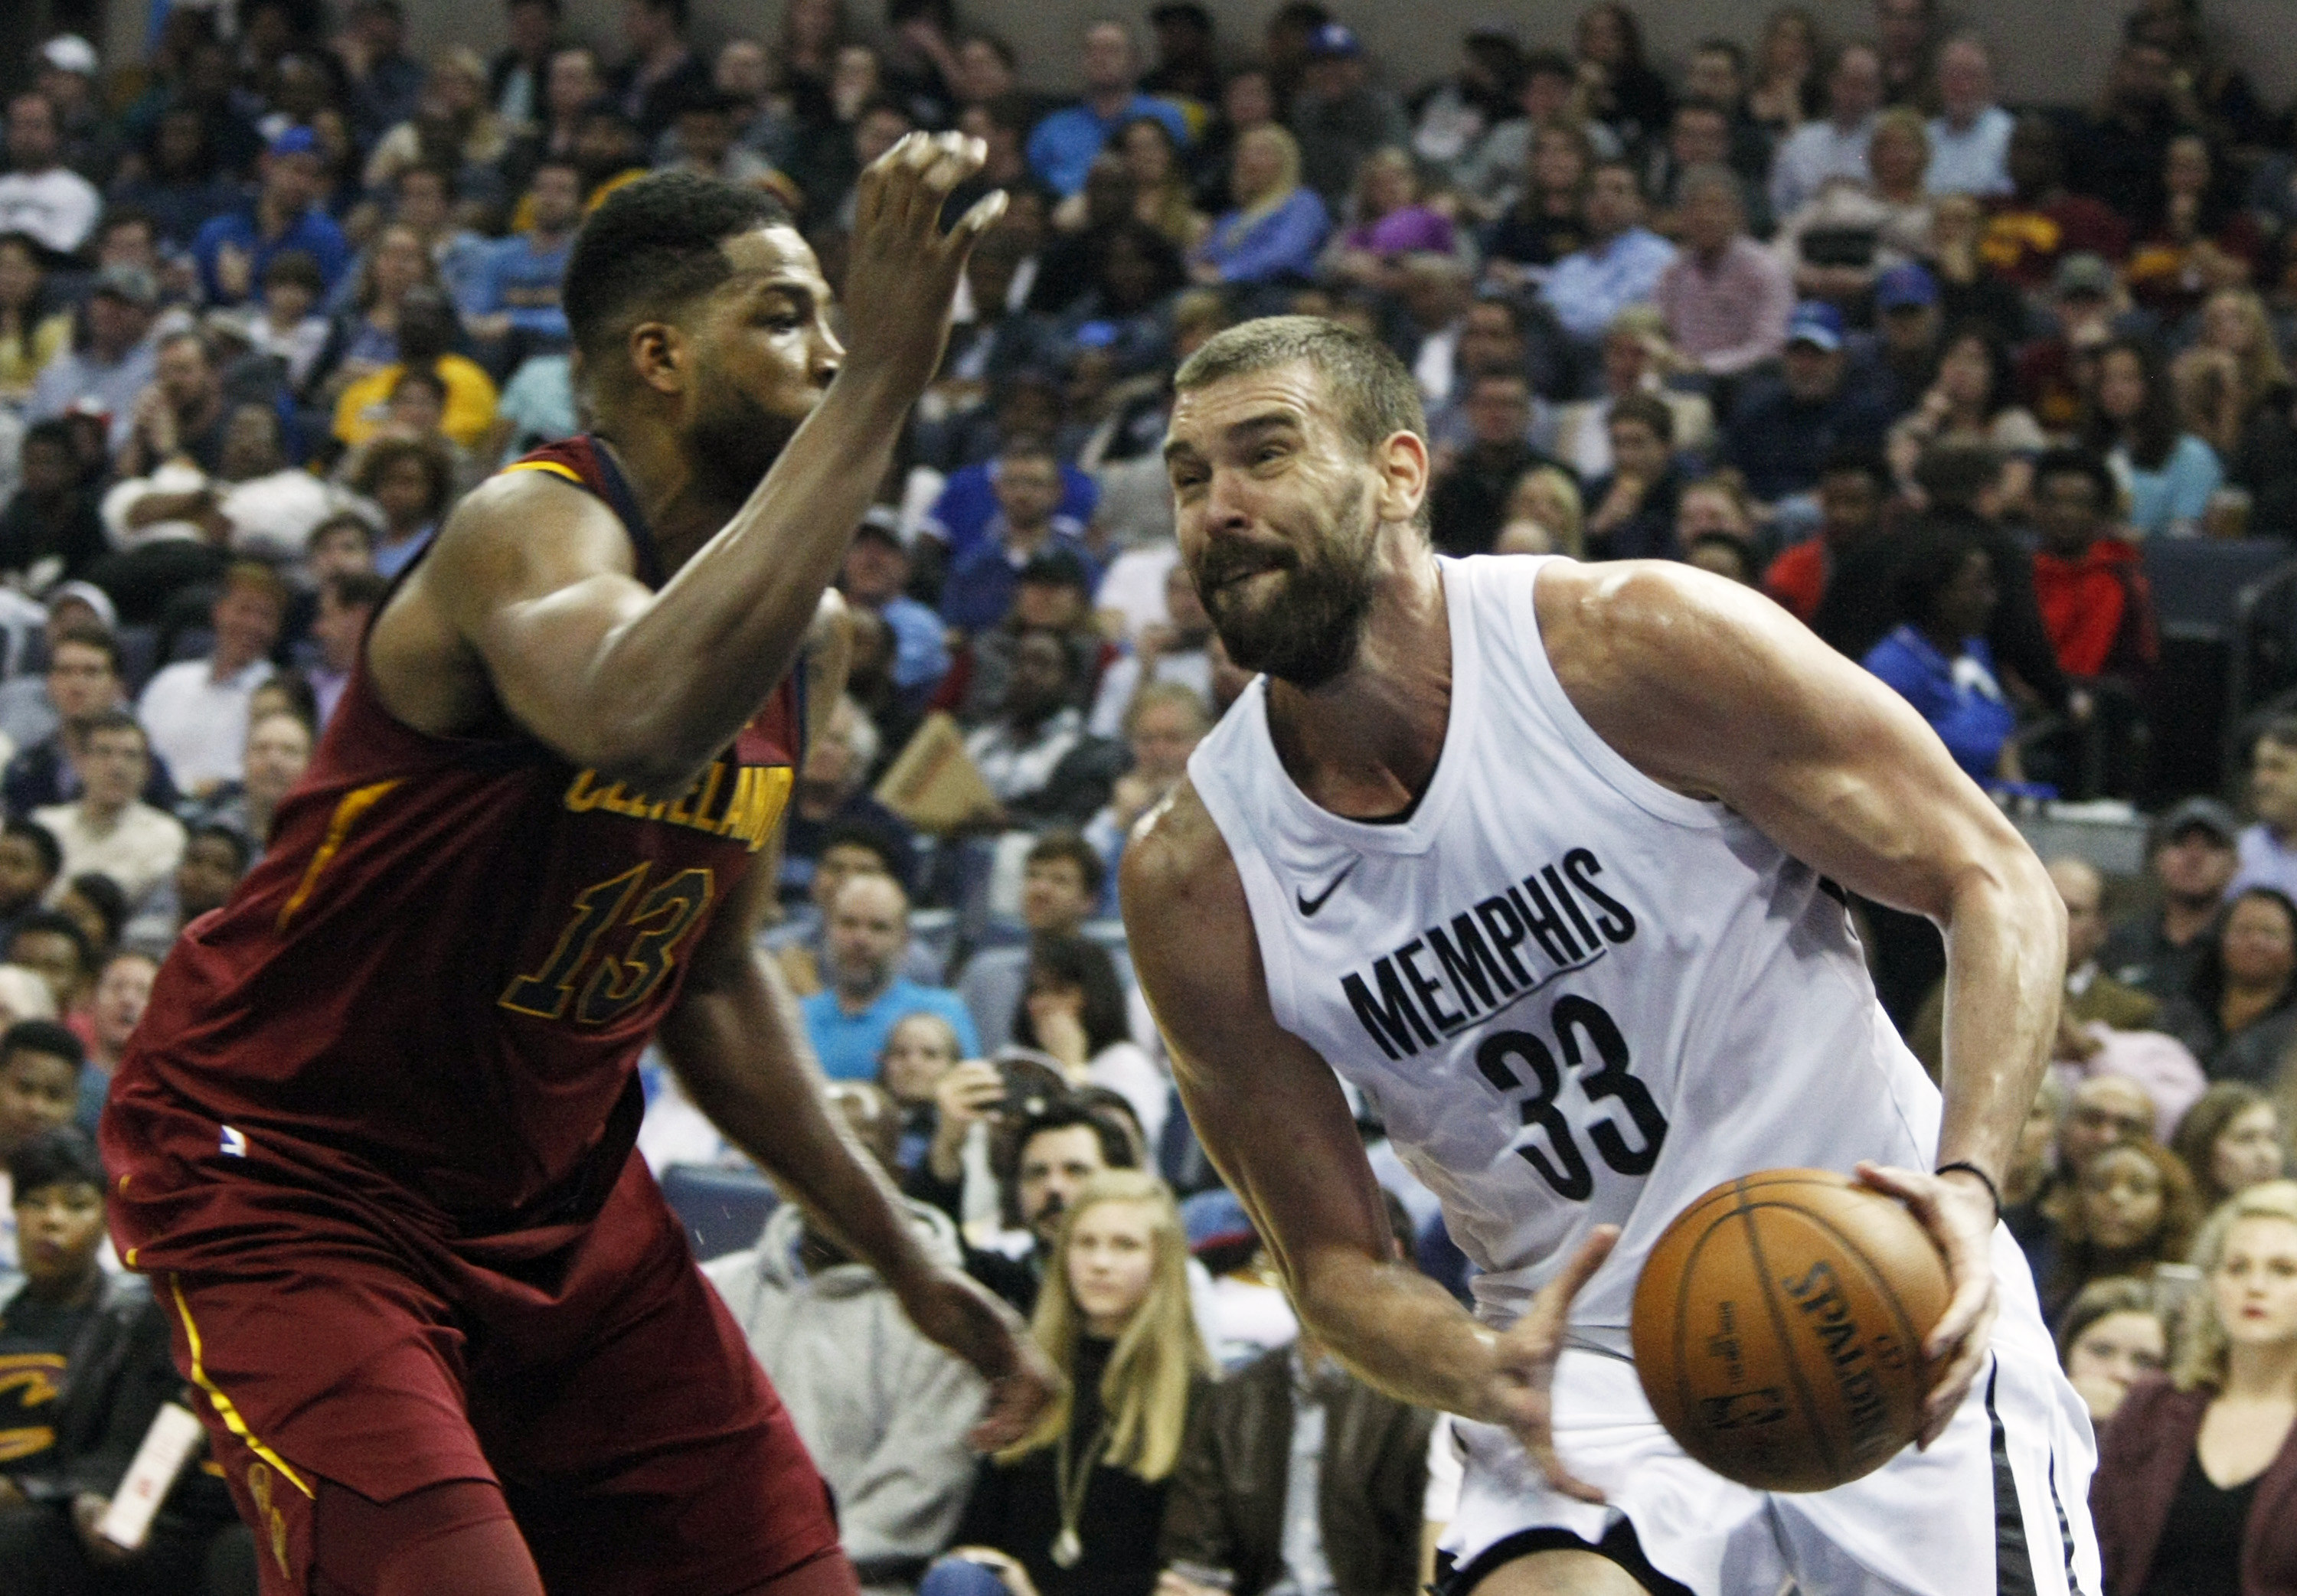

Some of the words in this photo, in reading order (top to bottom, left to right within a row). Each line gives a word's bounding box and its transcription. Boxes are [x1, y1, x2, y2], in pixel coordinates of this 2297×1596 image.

[498, 861, 715, 1024] 13
[1339, 847, 1637, 1062] MEMPHIS
[1475, 994, 1669, 1201] 33
